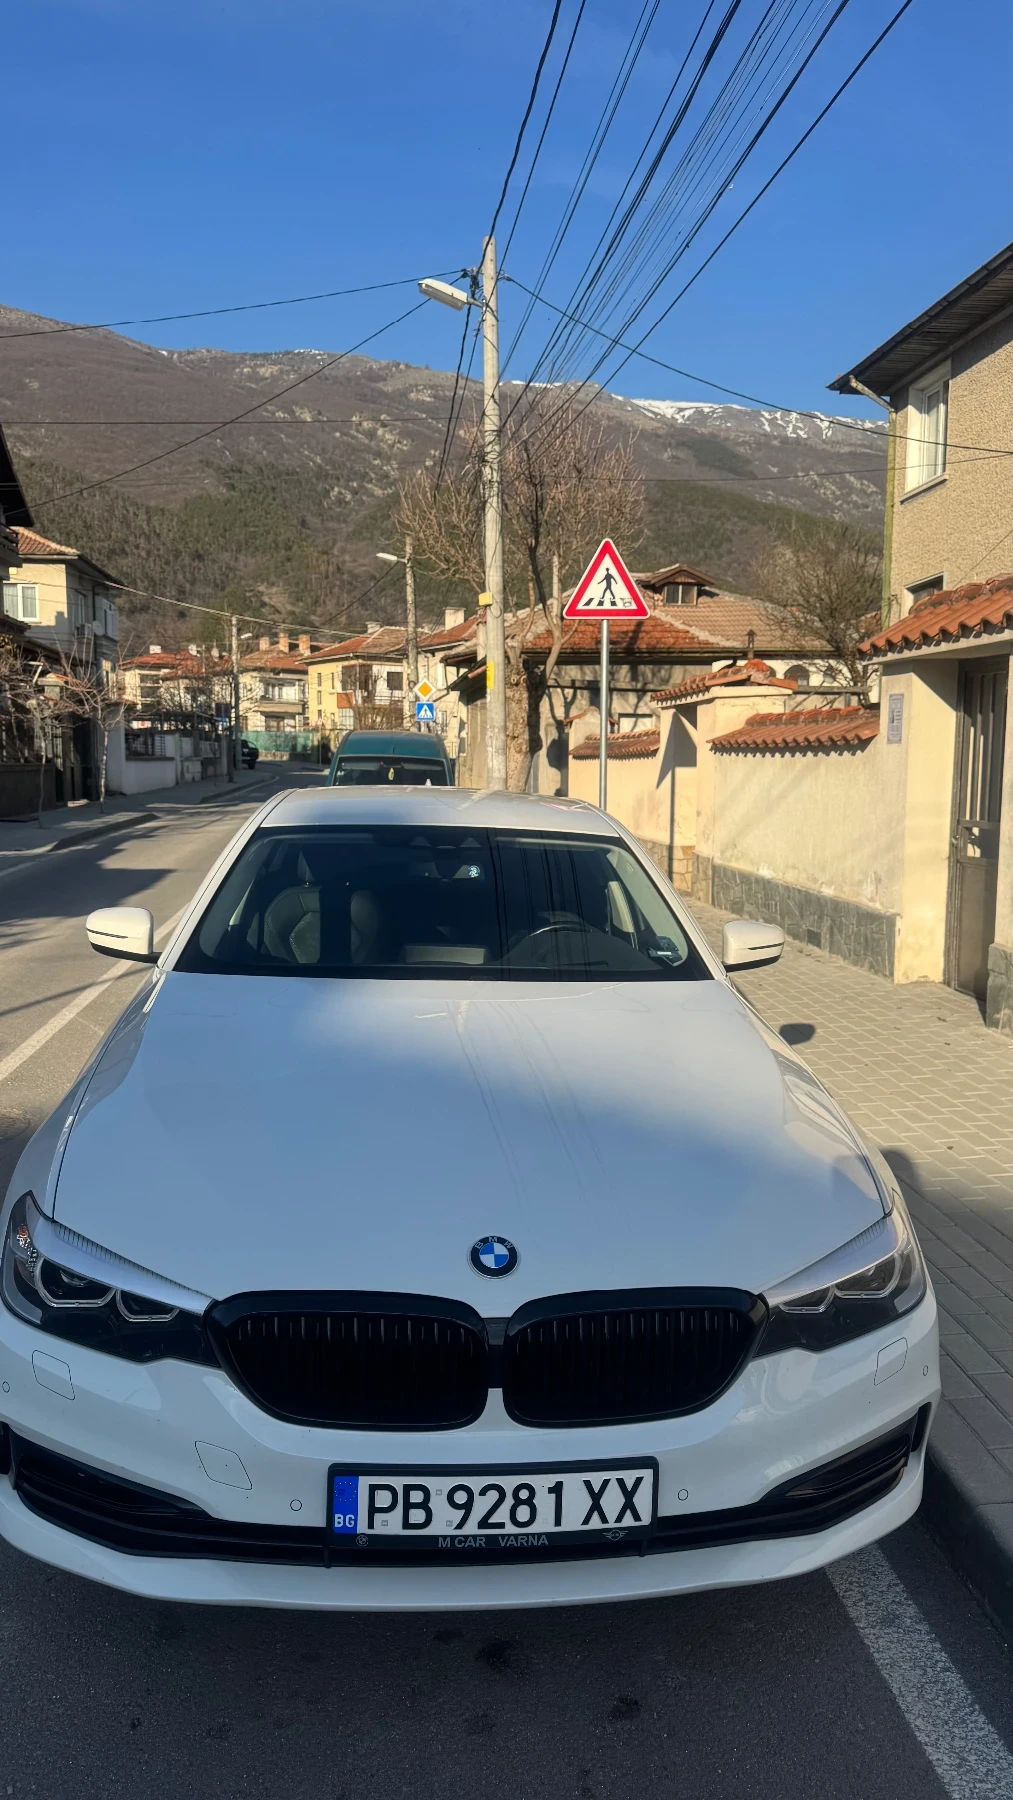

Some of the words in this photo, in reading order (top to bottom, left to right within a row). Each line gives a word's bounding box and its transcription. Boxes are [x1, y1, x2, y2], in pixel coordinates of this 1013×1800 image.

[474, 1236, 514, 1249] BMW
[367, 1483, 433, 1530] PB
[446, 1481, 564, 1530] 9281
[581, 1476, 645, 1526] XX
[334, 1513, 355, 1528] BG
[438, 1536, 451, 1548] M
[454, 1536, 486, 1548] CAR
[498, 1534, 549, 1547] VARNA
